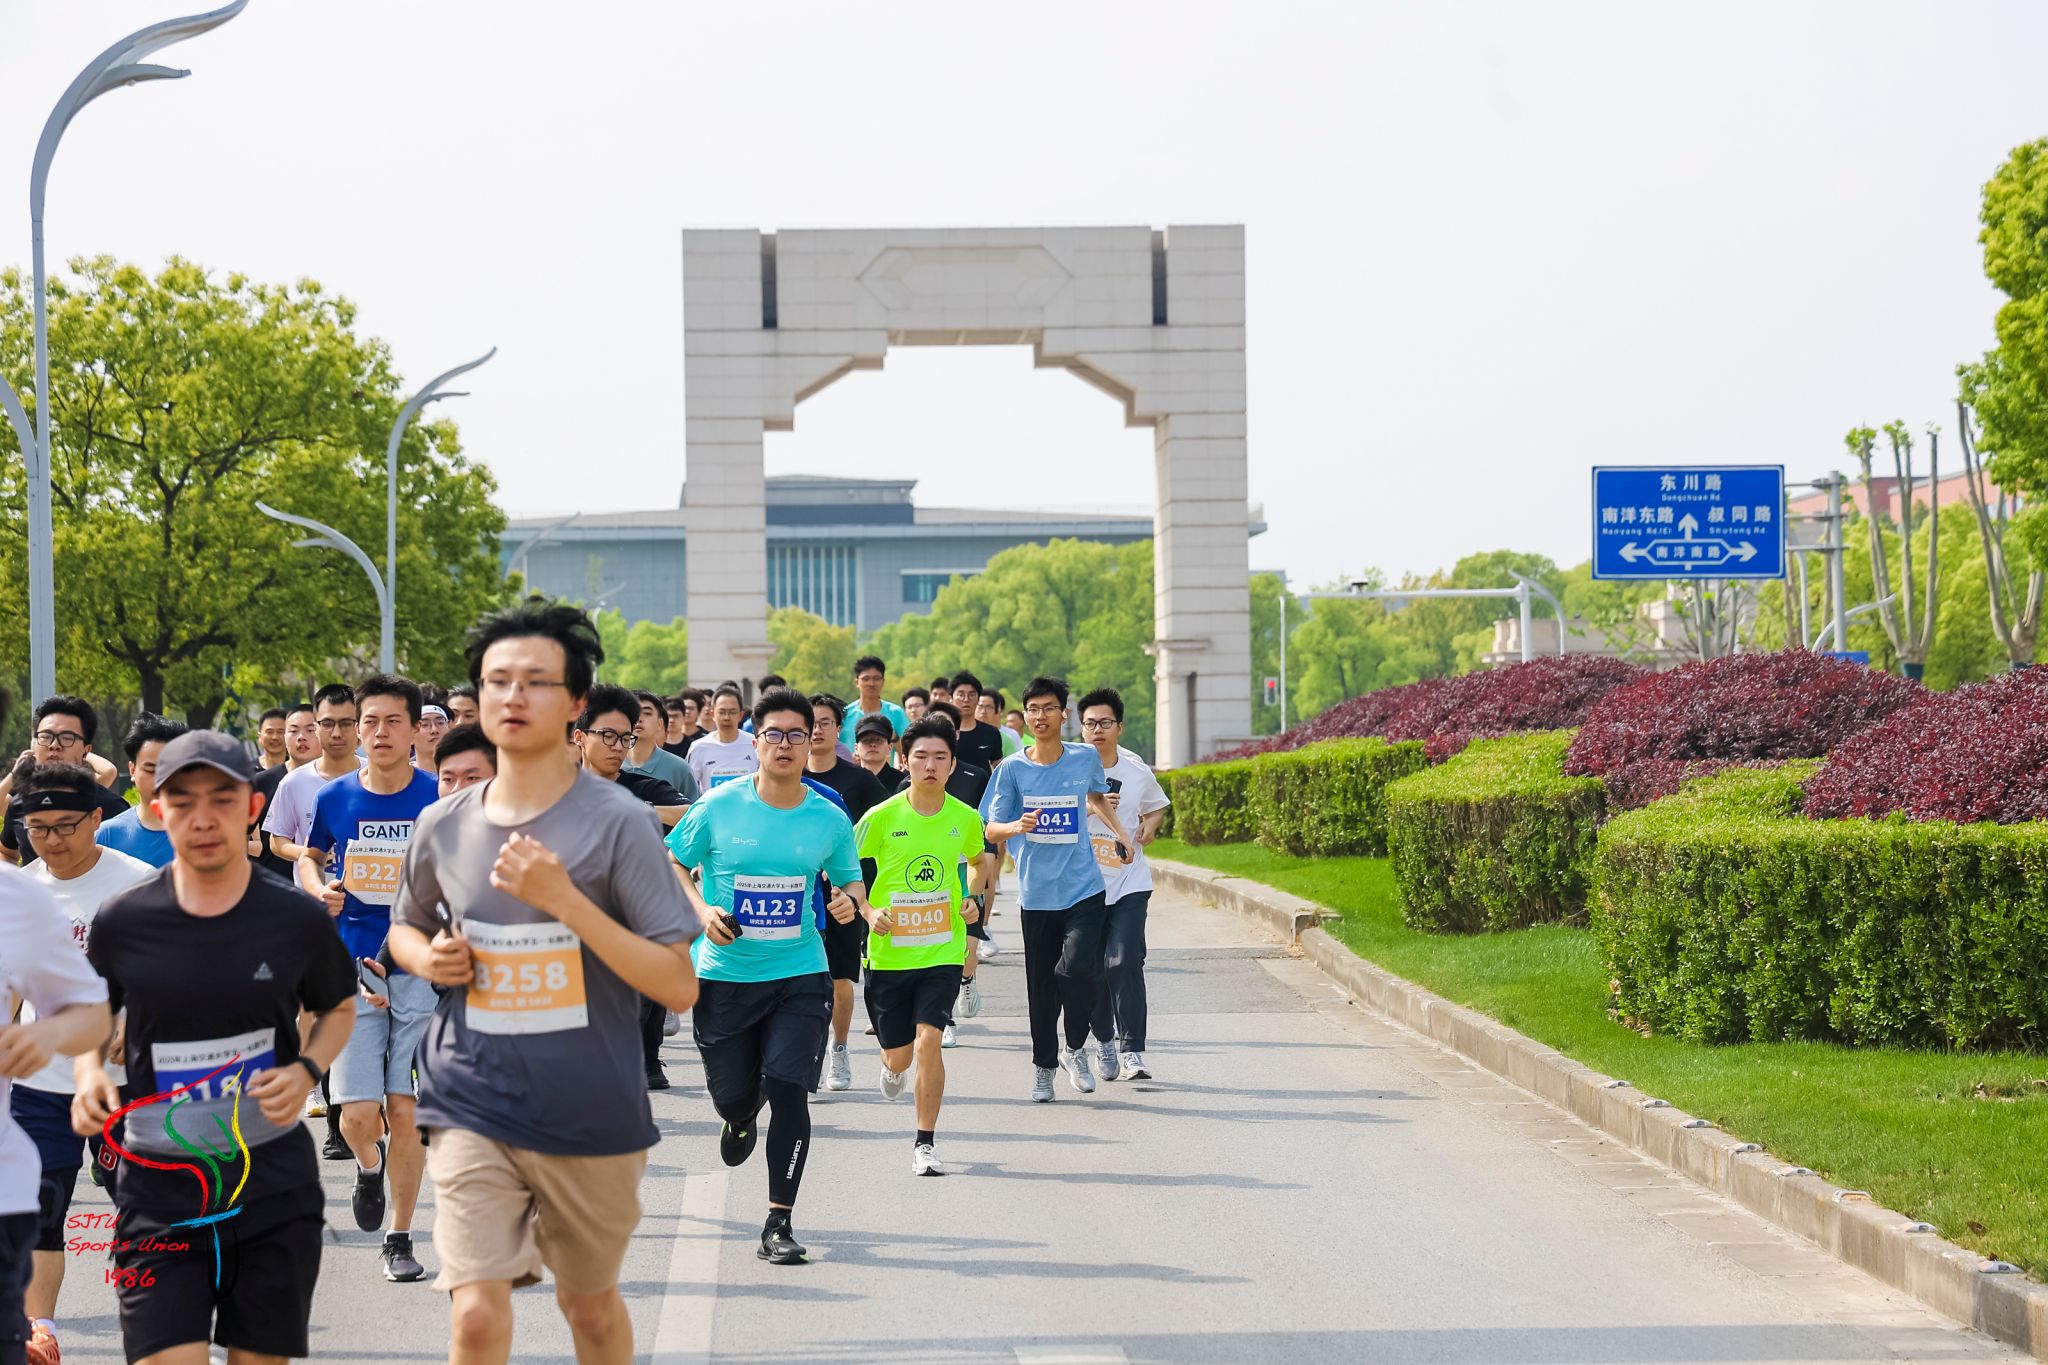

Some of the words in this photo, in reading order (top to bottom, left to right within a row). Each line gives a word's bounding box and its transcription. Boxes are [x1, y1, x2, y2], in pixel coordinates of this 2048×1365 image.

[1660, 474, 1722, 491] 东川路
[1661, 493, 1708, 502] Dongchuan
[1602, 506, 1674, 524] 南洋东路
[1708, 505, 1771, 523] 叔同路
[1602, 527, 1642, 536] Nanyang
[1709, 526, 1751, 536] Shutong
[1656, 545, 1721, 559] 南洋南路
[362, 825, 411, 839] GANT
[352, 862, 402, 881] B22
[739, 898, 797, 916] A123
[897, 909, 944, 928] B040
[474, 961, 569, 993] B258
